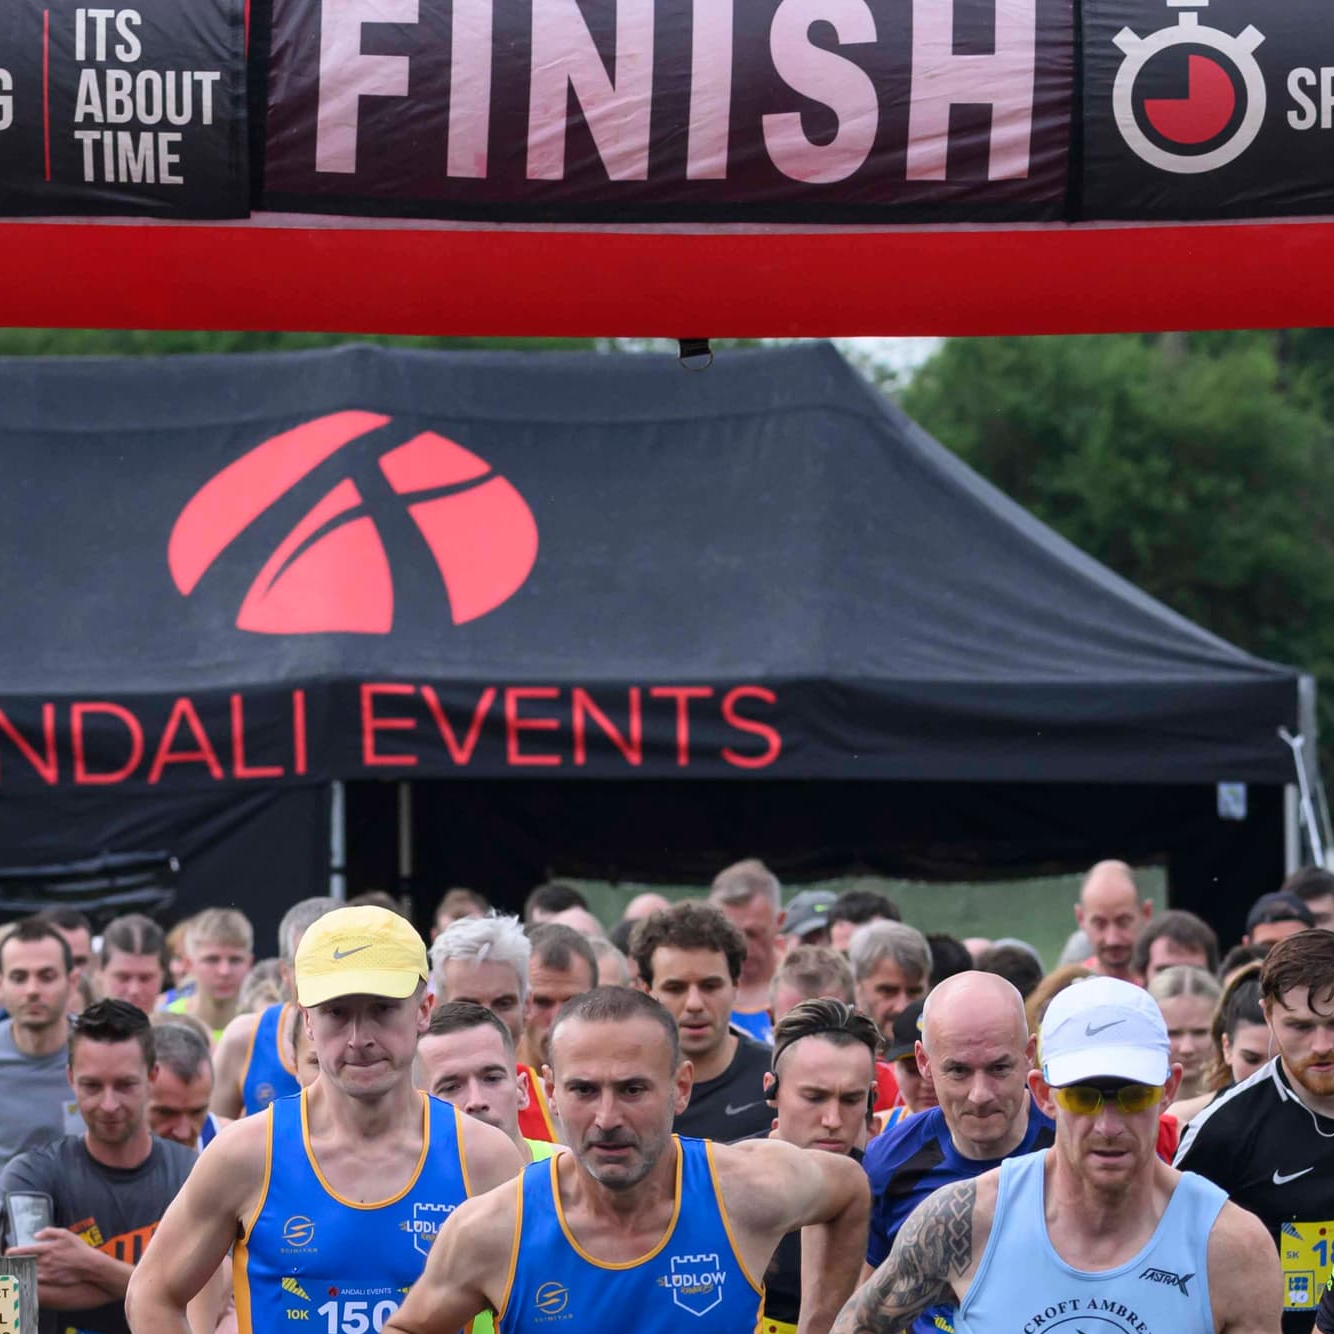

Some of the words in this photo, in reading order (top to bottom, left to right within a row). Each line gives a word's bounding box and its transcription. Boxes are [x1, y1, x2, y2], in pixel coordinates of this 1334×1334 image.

[75, 8, 141, 64] ITS
[73, 70, 221, 126] ABOUT
[316, 0, 1036, 183] FINISH
[74, 129, 184, 186] TIME
[360, 682, 783, 770] EVENTS
[367, 1287, 392, 1295] EVENTS
[664, 1271, 726, 1288] LUDLOW
[286, 1309, 309, 1320] 10K
